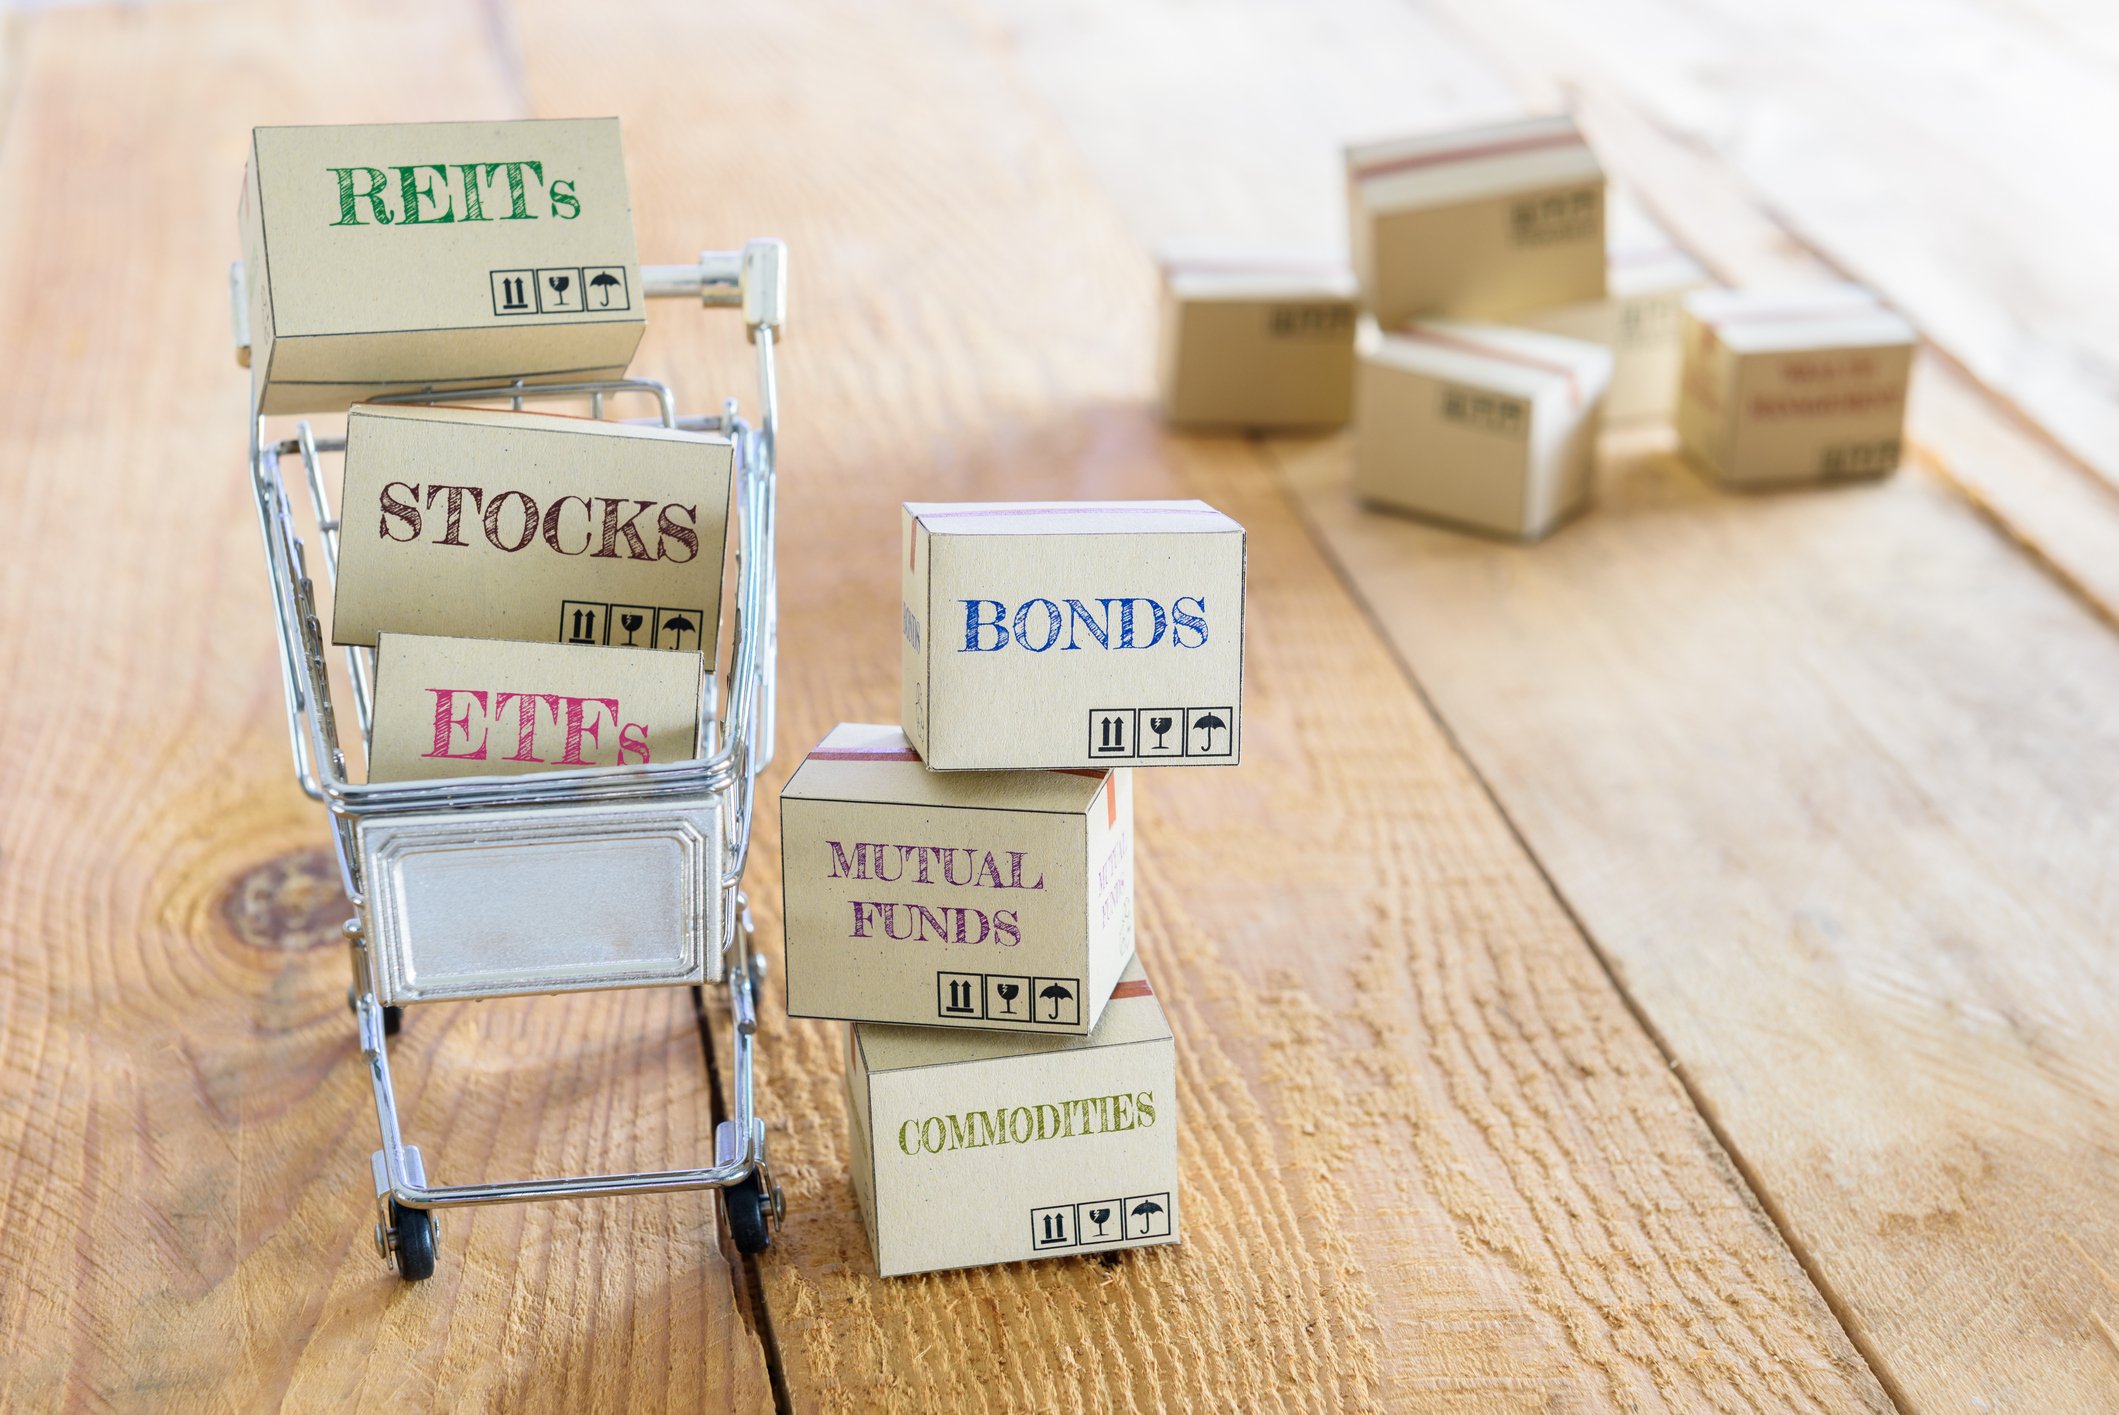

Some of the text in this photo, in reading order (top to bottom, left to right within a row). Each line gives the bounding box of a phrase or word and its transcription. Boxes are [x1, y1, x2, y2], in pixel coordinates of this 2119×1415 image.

[325, 160, 581, 227] REITs
[379, 481, 700, 564] STOCKS
[957, 595, 1210, 654] BONDS
[421, 688, 651, 766] ETFs
[827, 840, 1044, 891] MUTUAL
[851, 899, 1021, 946] FUNDS
[898, 1091, 1157, 1155] COMMODITIES
